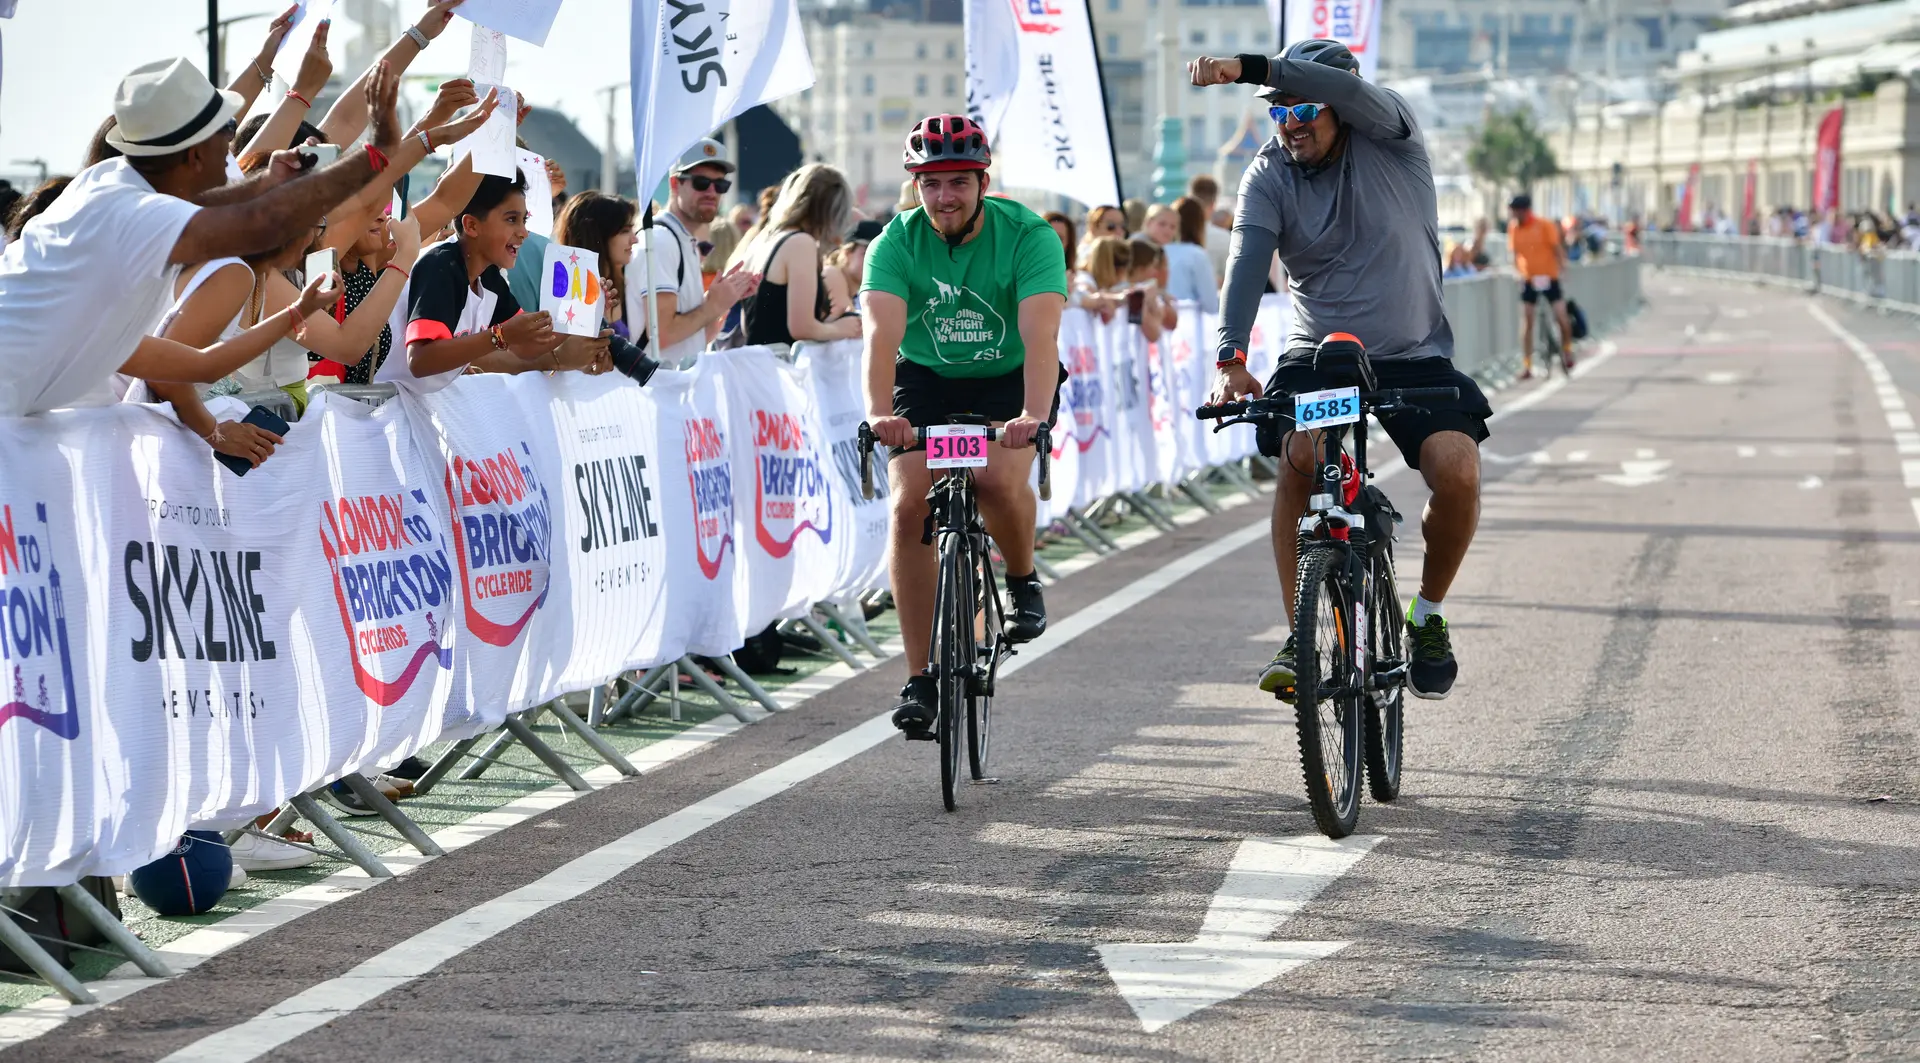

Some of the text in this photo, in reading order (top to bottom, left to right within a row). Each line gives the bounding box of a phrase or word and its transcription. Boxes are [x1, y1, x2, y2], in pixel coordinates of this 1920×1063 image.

[552, 261, 600, 305] DAD
[940, 320, 983, 335] TH FIGHT
[956, 309, 984, 321] OINED
[949, 330, 993, 342] WILDLIFE
[973, 348, 1004, 360] ZSL
[1302, 398, 1352, 421] 6585
[933, 437, 980, 458] 5103
[186, 506, 201, 525] TO
[574, 455, 659, 553] SKYLINE
[323, 494, 432, 556] LONDON TO
[18, 535, 41, 573] TO
[342, 550, 451, 623] BRIGHTON
[475, 569, 532, 599] CYCLE RIDE
[125, 539, 277, 663] SKYLINE
[359, 624, 409, 656] CYCLE RIDE
